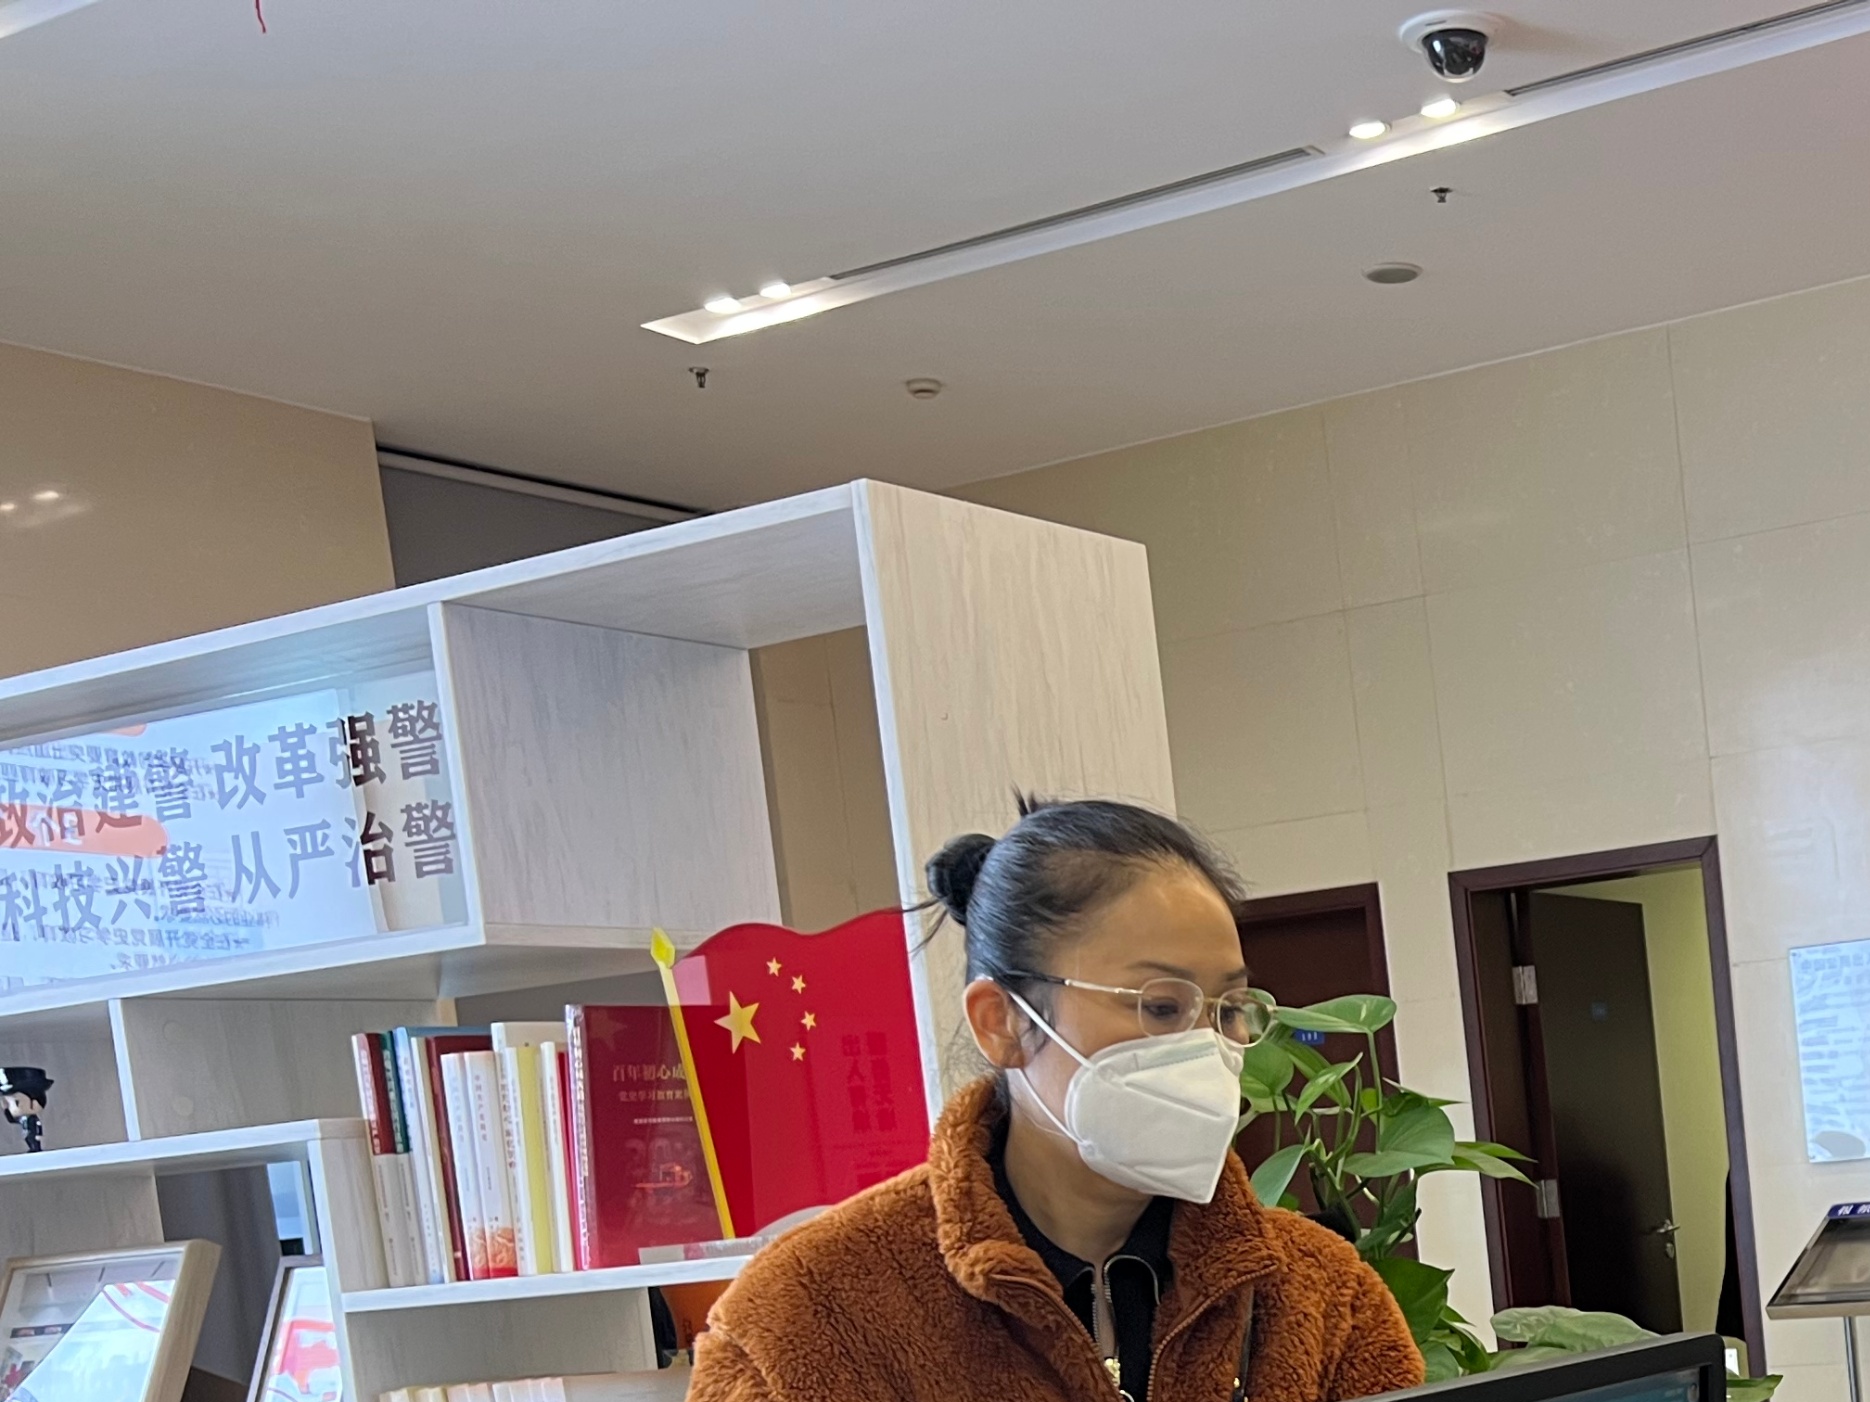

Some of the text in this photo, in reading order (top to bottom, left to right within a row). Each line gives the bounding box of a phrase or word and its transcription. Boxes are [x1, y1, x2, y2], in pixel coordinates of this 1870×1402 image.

[211, 699, 443, 810] 改革强警
[0, 799, 456, 942] 科技兴警 从严治警
